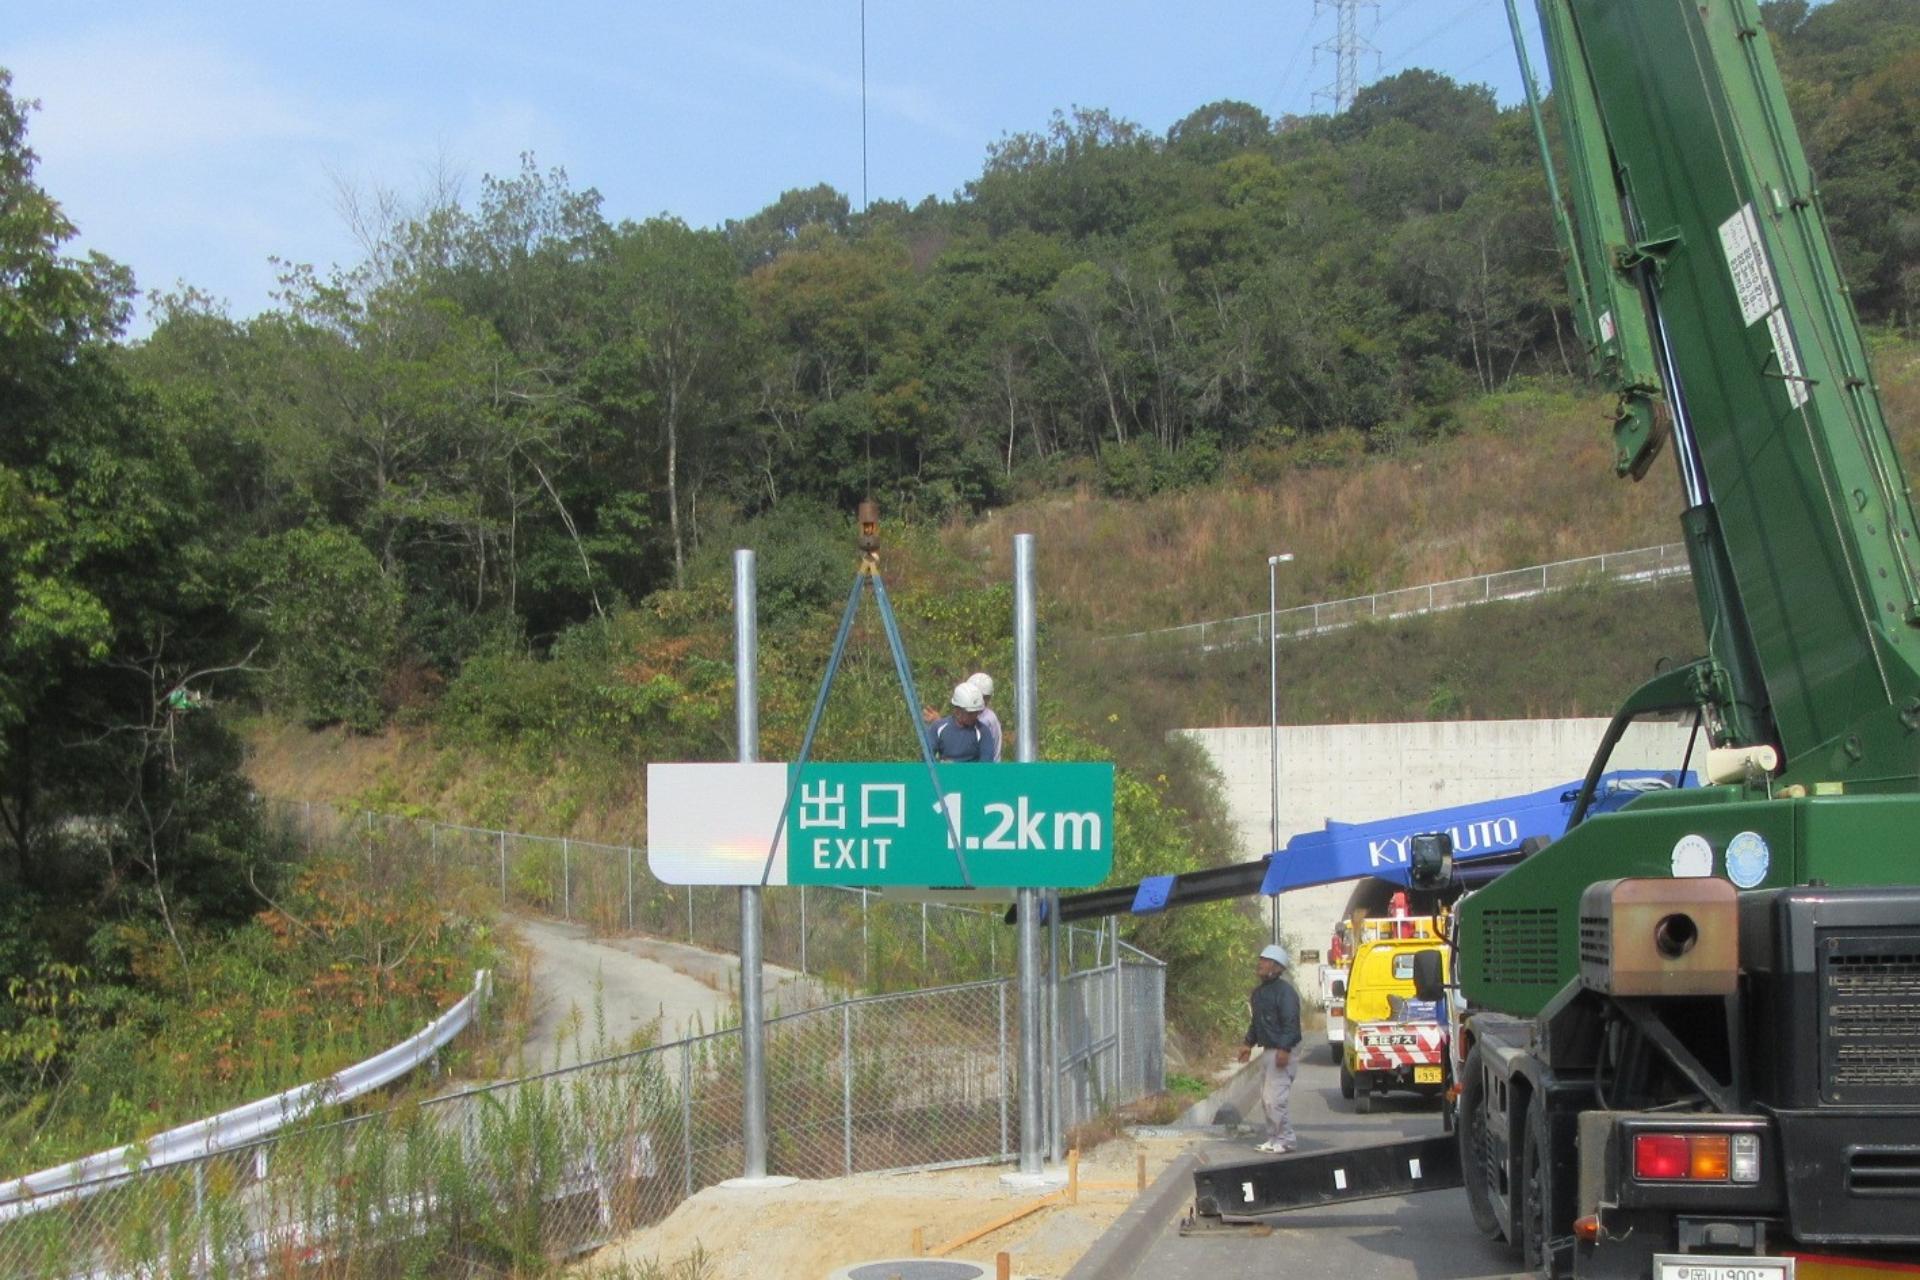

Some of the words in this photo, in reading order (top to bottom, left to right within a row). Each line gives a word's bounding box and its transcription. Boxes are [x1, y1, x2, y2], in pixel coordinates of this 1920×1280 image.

[800, 779, 906, 831] 出口
[813, 839, 892, 869] EXIT
[1368, 817, 1519, 867] KYUTO
